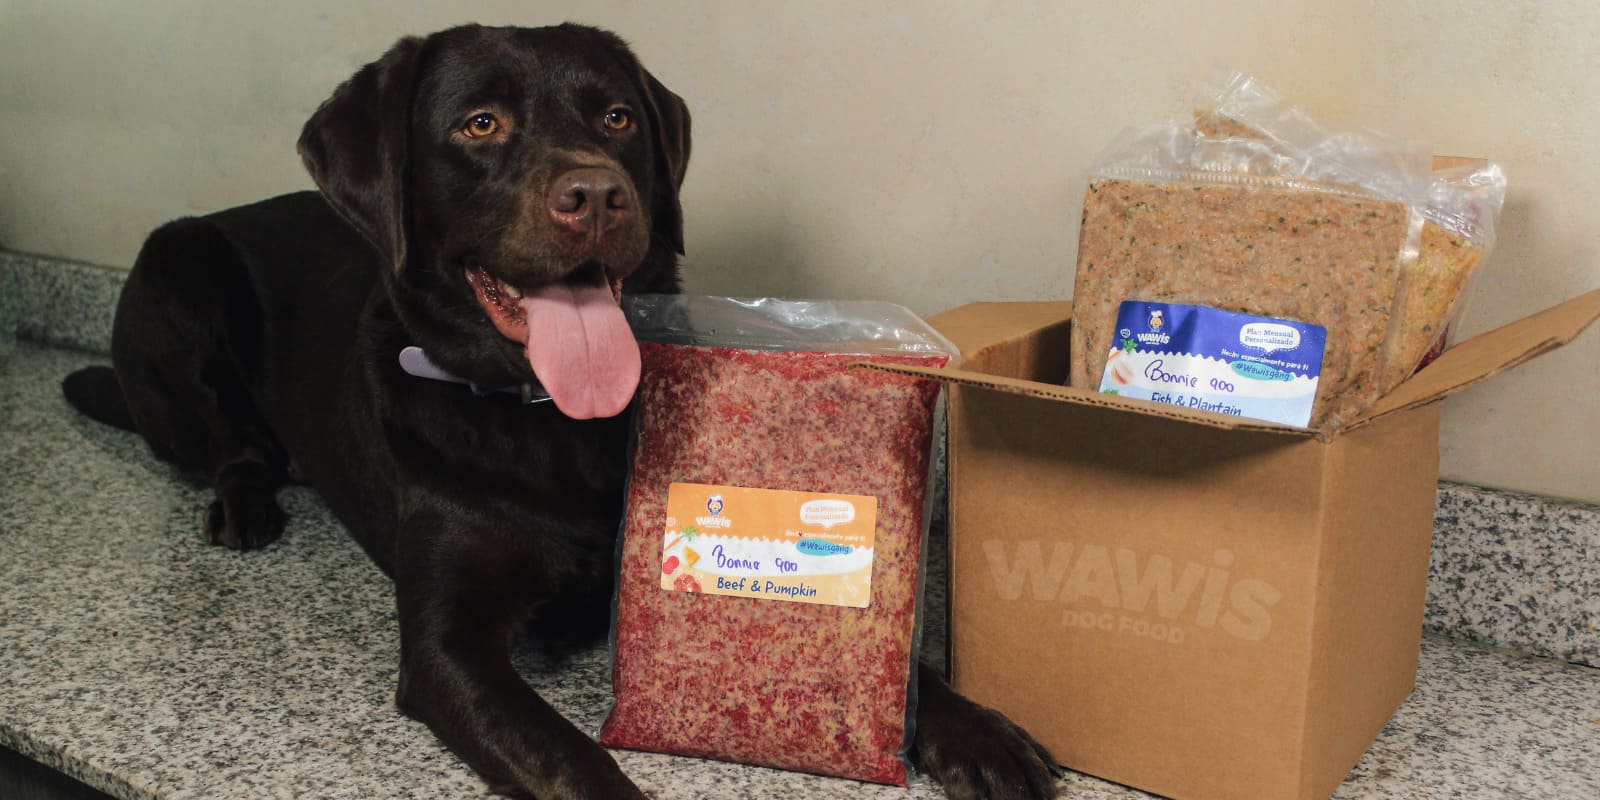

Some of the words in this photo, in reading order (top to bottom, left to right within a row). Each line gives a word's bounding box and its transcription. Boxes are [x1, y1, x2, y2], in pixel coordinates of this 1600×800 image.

[1245, 335, 1294, 346] Personalizado
[1263, 329, 1294, 338] Mensual
[1221, 348, 1240, 358] Hecho
[1241, 355, 1285, 367] especialmente
[1286, 361, 1301, 370] para
[1302, 363, 1309, 371] ti
[1144, 359, 1198, 389] Bonnie
[1236, 363, 1290, 382] #Wawisgang
[1151, 392, 1171, 404] Fish
[1175, 395, 1186, 407] &
[1189, 396, 1242, 416] Plantain
[712, 544, 760, 570] Bonnie
[800, 540, 850, 555] #Wawisgang
[717, 576, 747, 591] Beef
[750, 580, 761, 592] &
[765, 581, 817, 598] Pumpkin
[1062, 609, 1114, 632] DOG
[1118, 616, 1186, 645] FOOD
